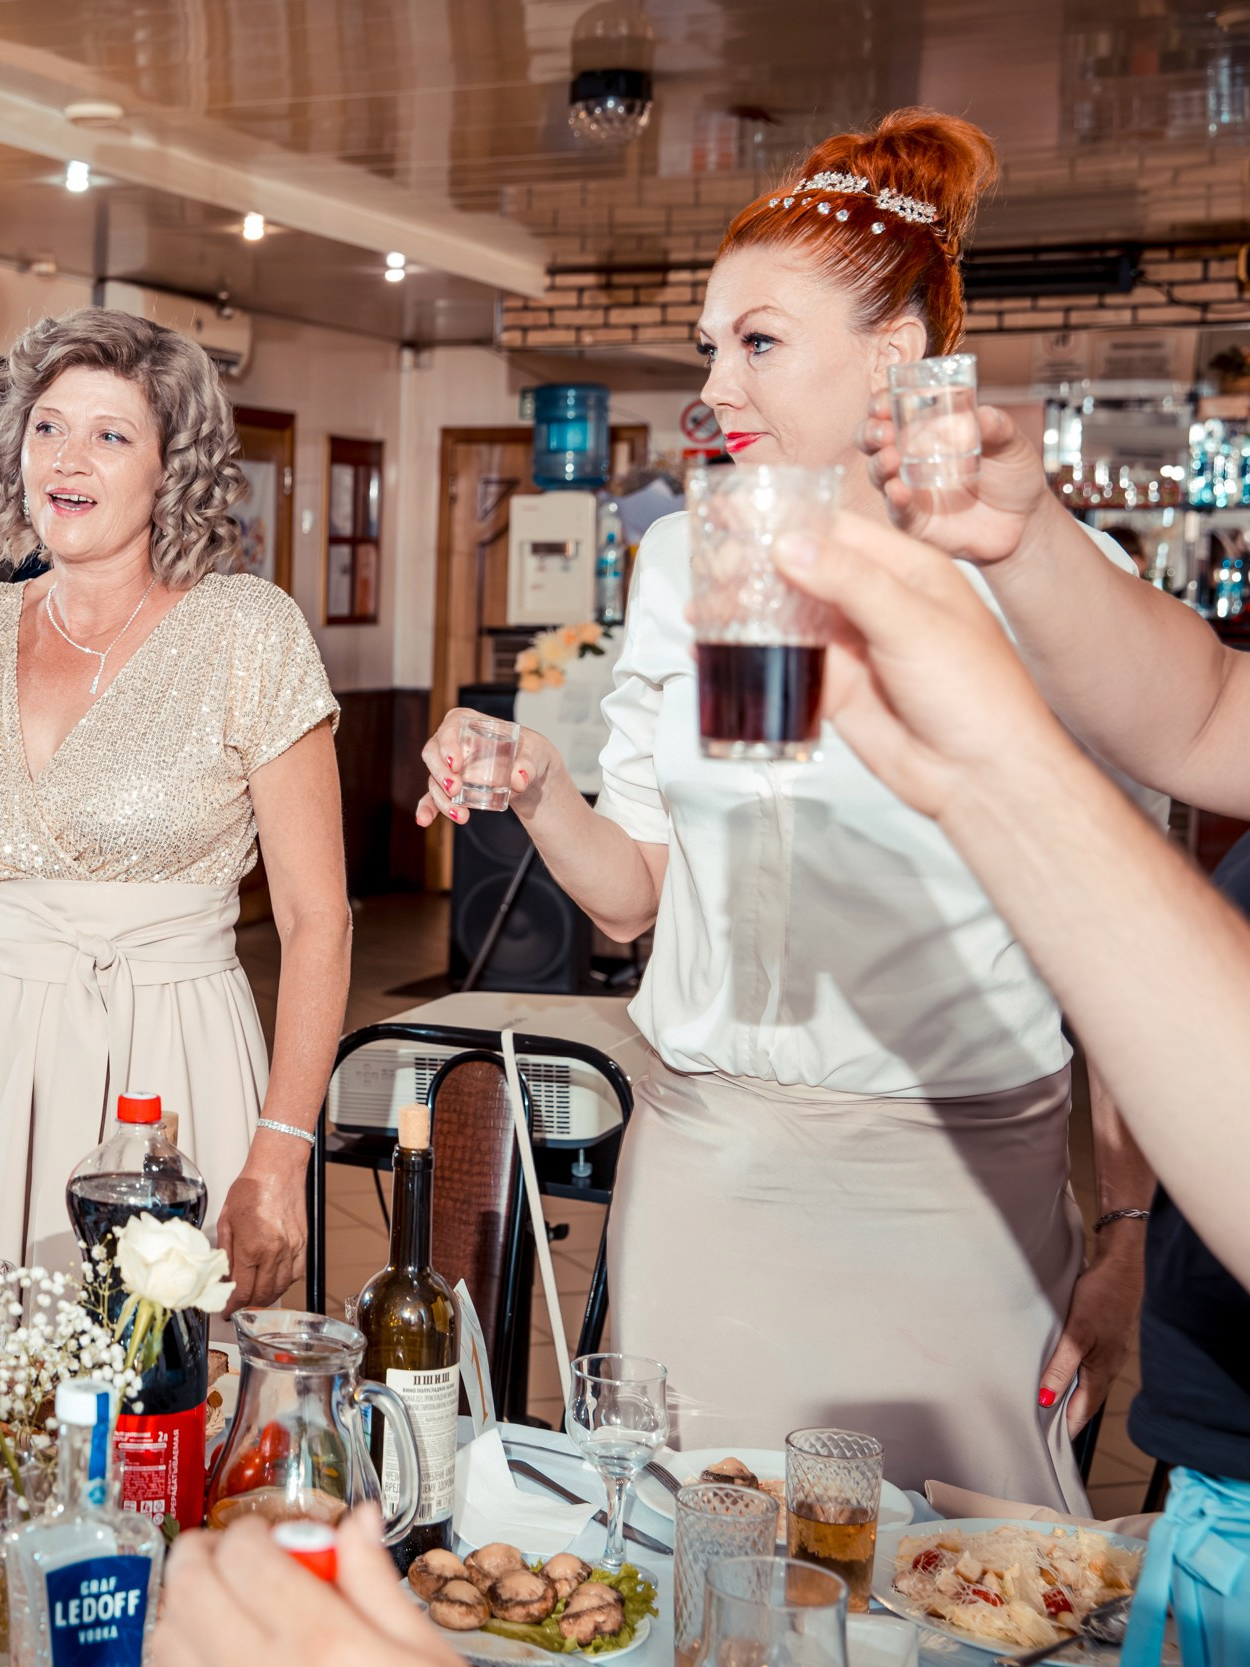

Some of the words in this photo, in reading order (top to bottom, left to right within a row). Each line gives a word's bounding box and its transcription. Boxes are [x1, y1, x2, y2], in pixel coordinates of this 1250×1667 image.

[413, 1372, 450, 1385] ПШИШ
[55, 1589, 141, 1627] LEDOFF
[78, 1625, 119, 1645] VODKA
